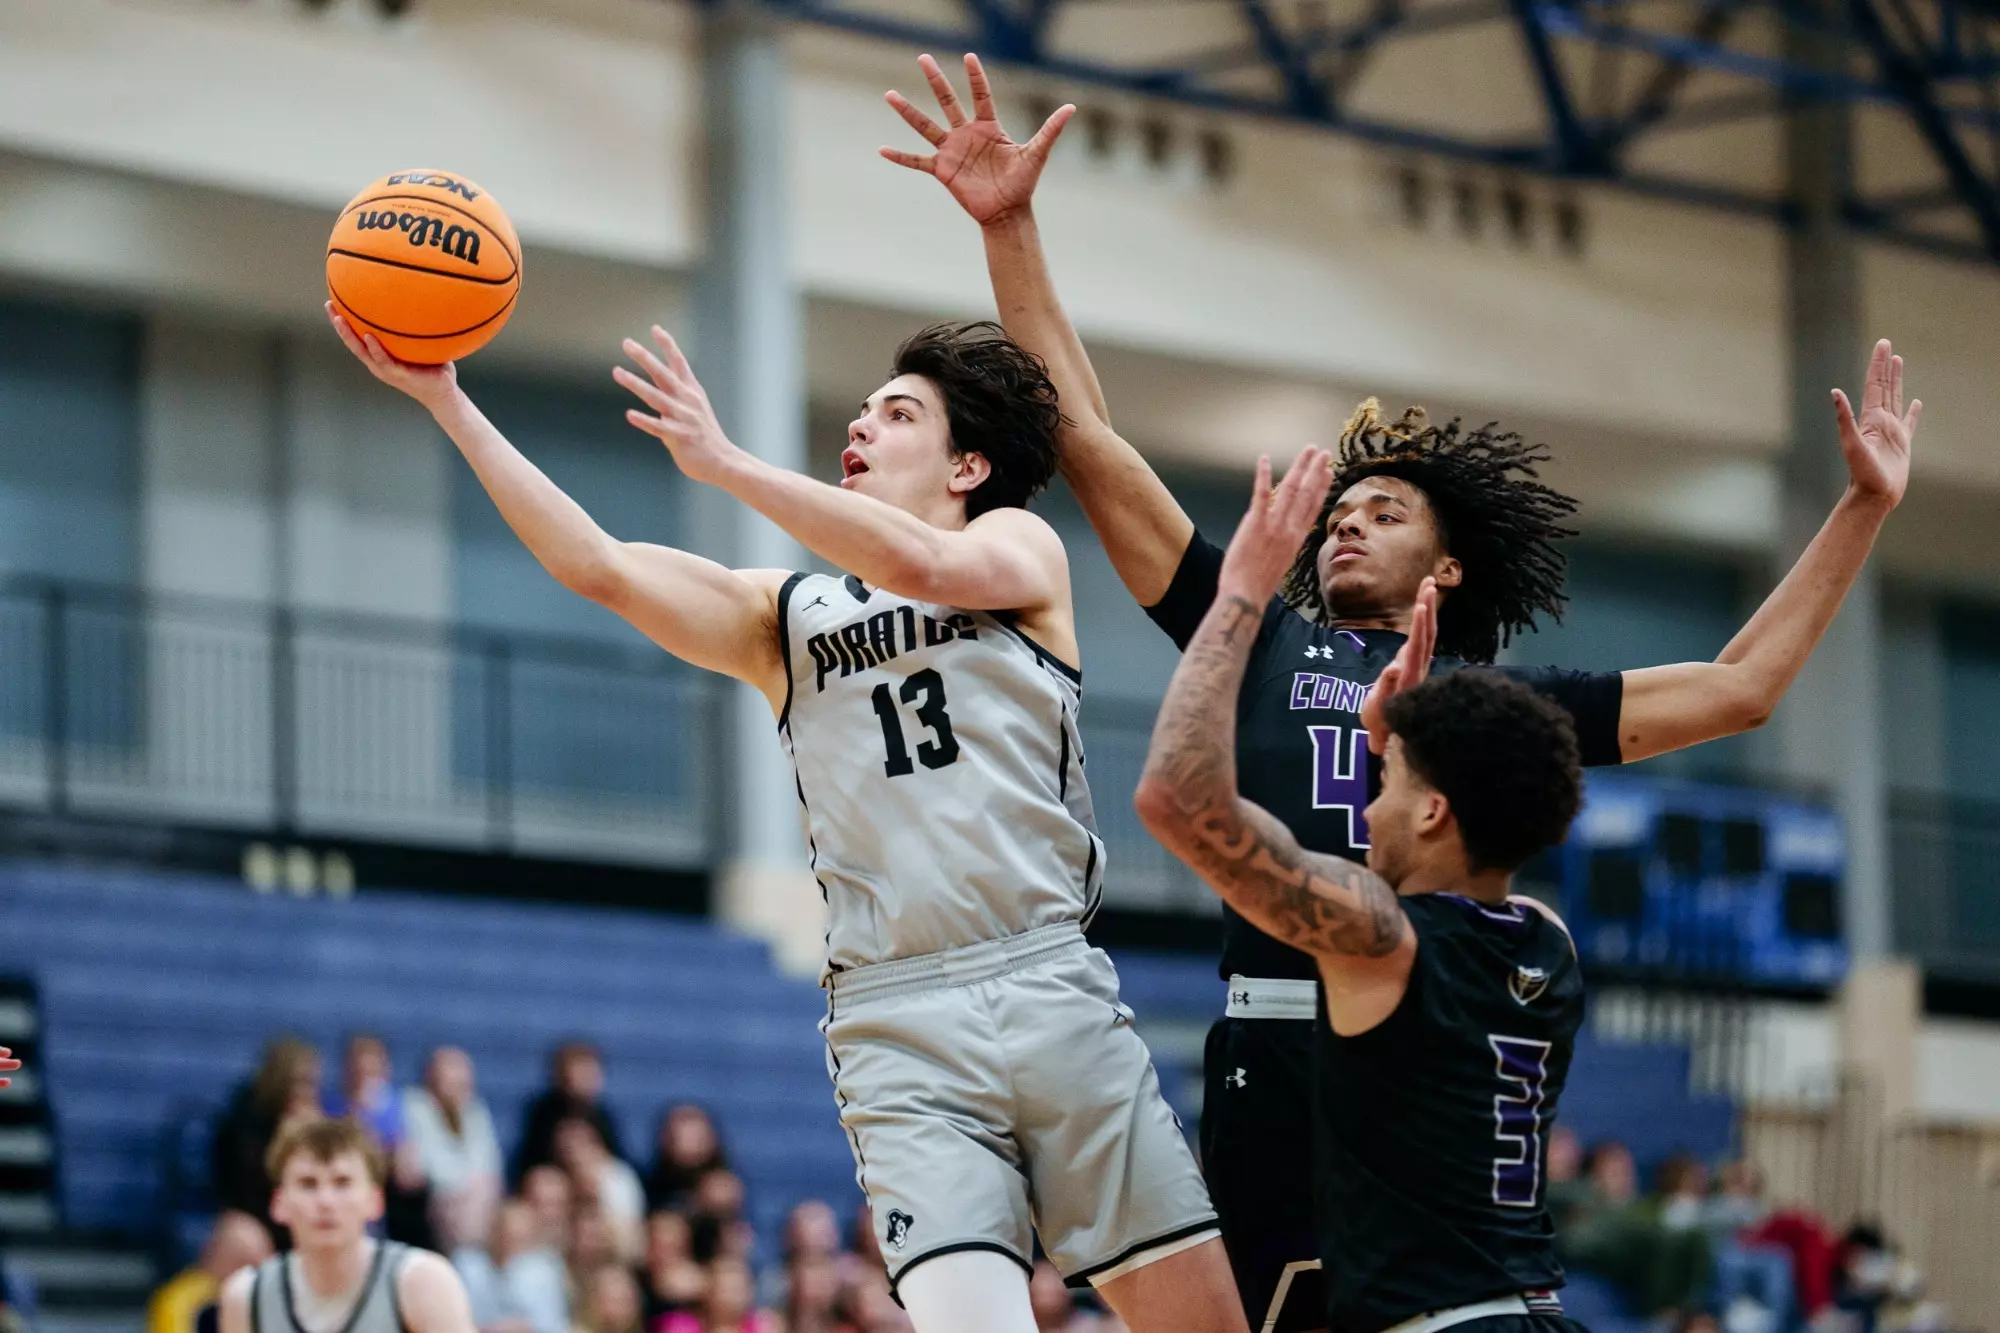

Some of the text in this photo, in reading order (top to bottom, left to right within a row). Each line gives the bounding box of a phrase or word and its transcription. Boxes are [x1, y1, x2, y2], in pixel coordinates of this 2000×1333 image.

[357, 211, 480, 265] Wilson
[387, 173, 480, 201] NCAA
[871, 667, 960, 778] 13
[1306, 725, 1373, 849] 4
[1487, 1034, 1552, 1207] 3
